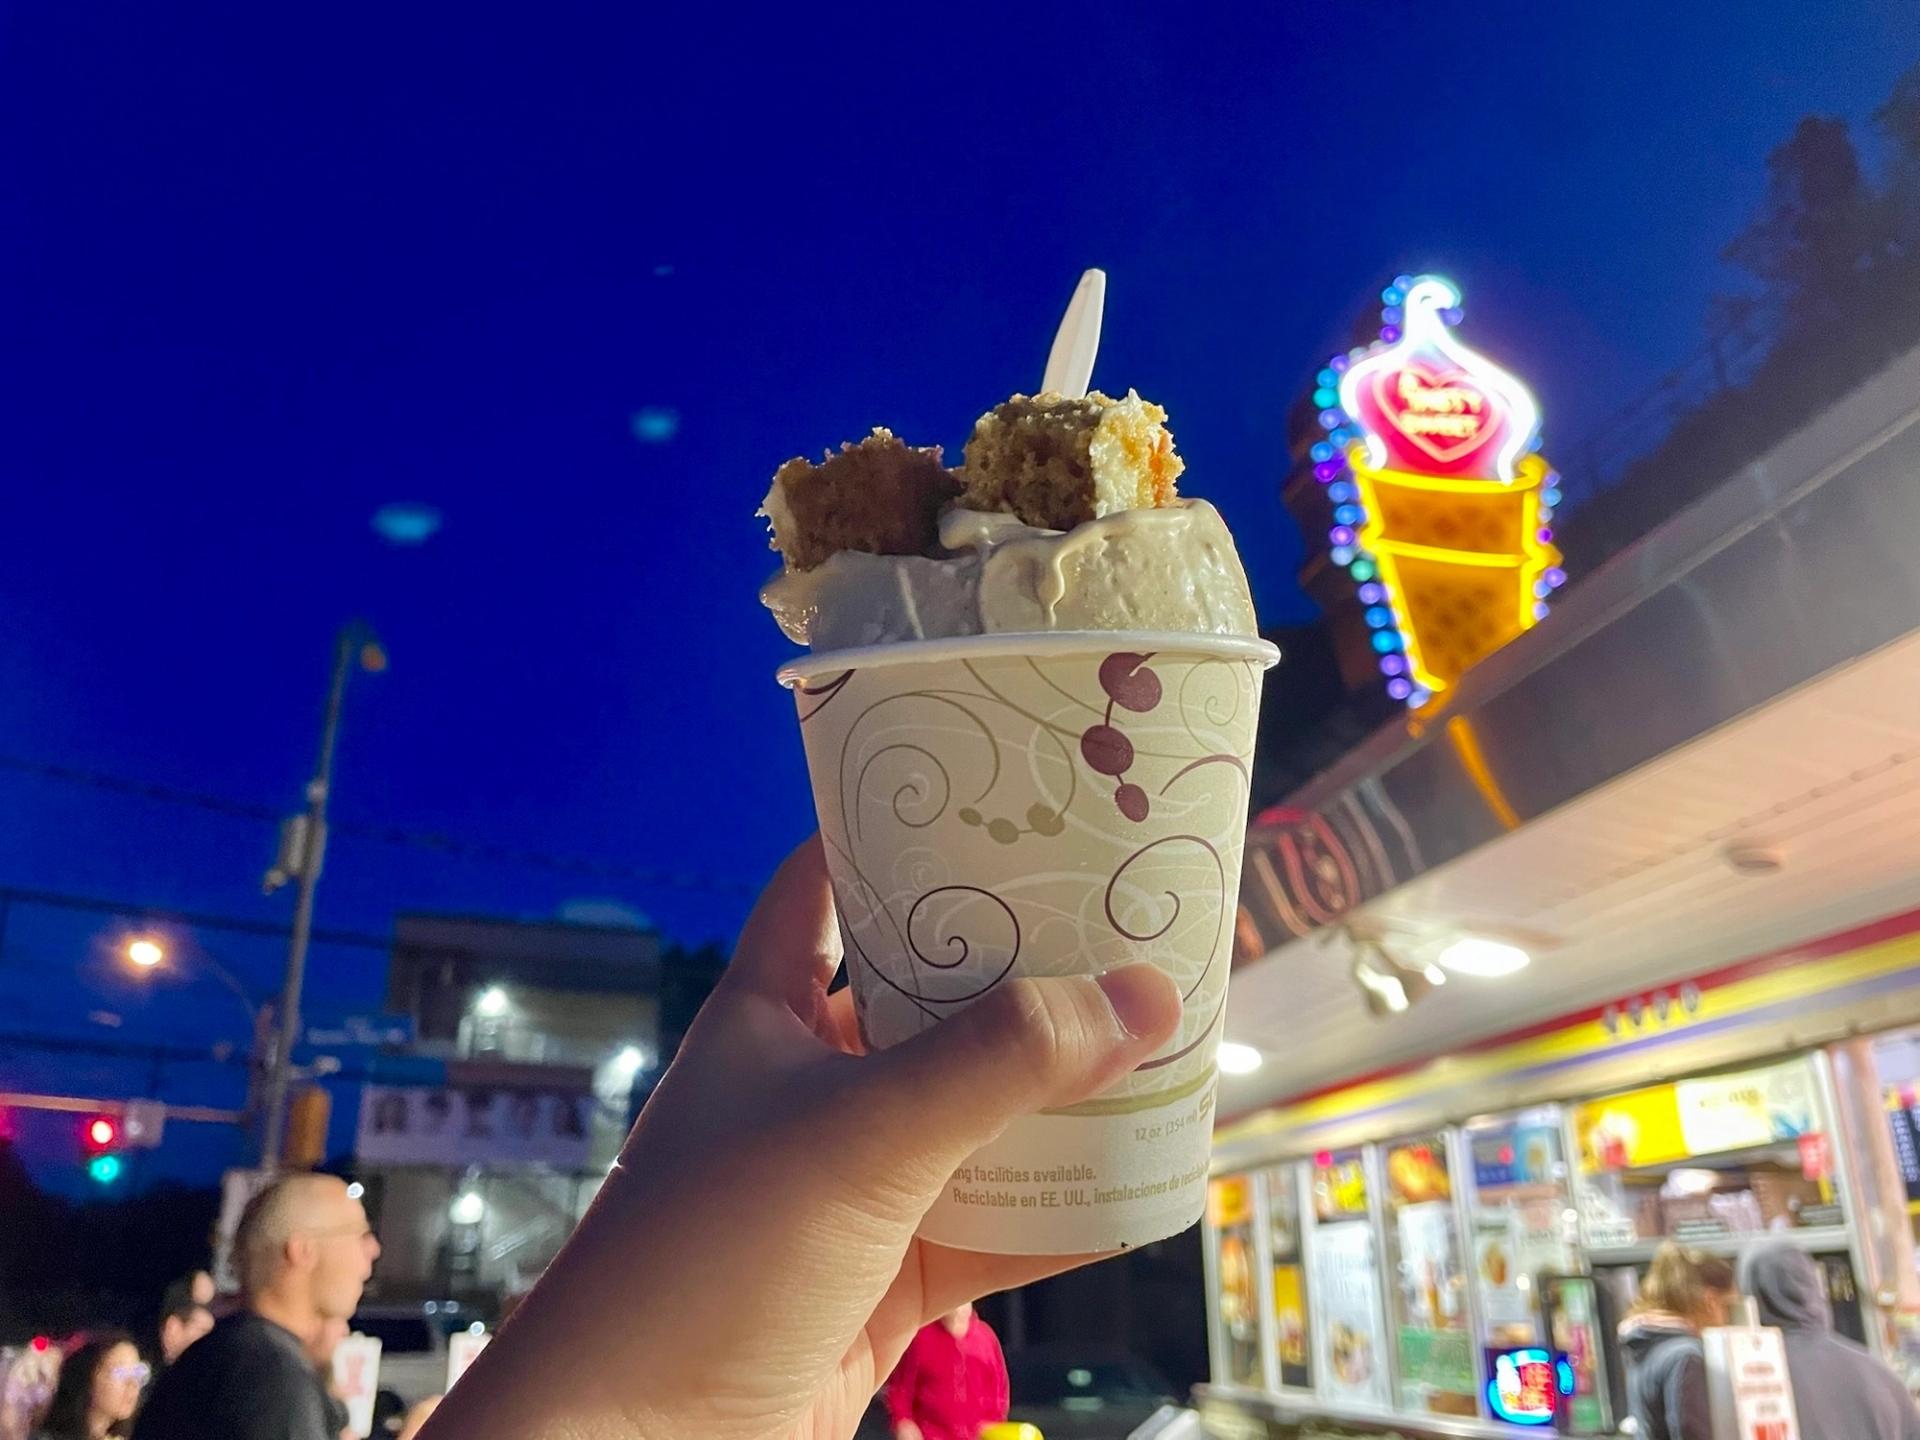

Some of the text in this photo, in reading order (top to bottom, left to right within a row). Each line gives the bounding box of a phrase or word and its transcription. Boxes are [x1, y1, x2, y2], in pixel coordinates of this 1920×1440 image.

[975, 1165, 1030, 1183] facilities
[1033, 1164, 1096, 1183] available.
[953, 1187, 1017, 1208] Reciclable
[1020, 1195, 1037, 1207] en
[1093, 1181, 1168, 1204] instalaciones
[1169, 1175, 1180, 1191] de
